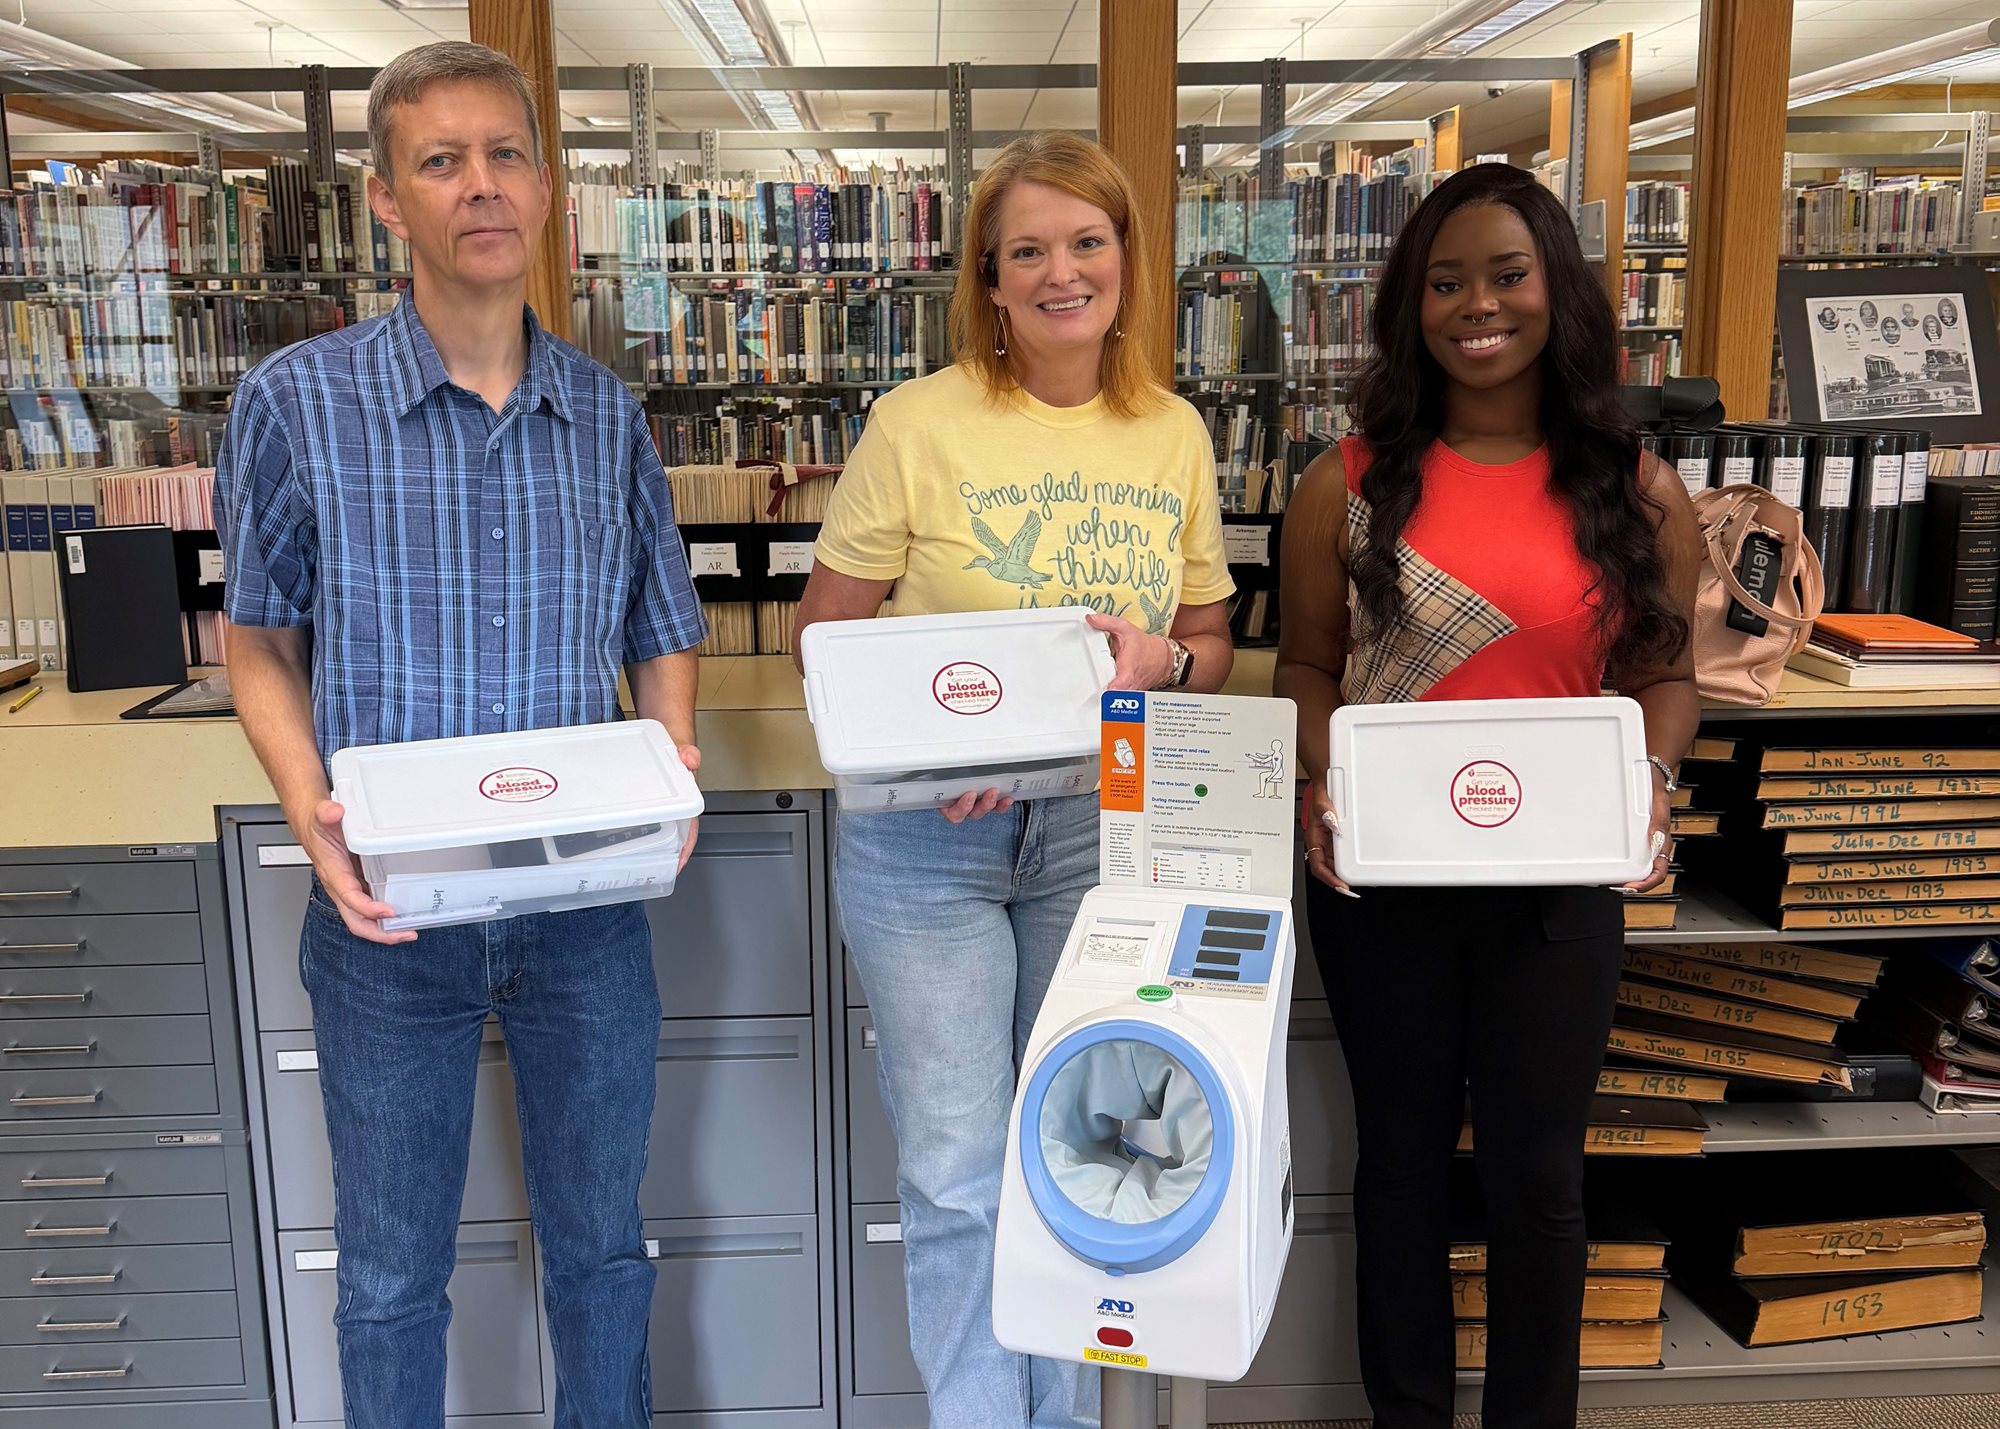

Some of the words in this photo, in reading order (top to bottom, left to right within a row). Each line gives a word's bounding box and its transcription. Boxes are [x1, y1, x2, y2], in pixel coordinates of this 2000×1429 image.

[819, 211, 829, 240] JESUS
[959, 481, 1027, 515] Some
[1031, 471, 1088, 520] glad
[1094, 482, 1184, 551] morning
[1066, 506, 1151, 549] when
[707, 562, 722, 571] AR
[785, 562, 800, 571] AR
[1048, 546, 1122, 587] this
[1122, 549, 1171, 600] life
[947, 680, 987, 691] blood
[942, 689, 998, 702] pressure
[1110, 699, 1140, 710] AND
[1922, 753, 1951, 768] 92
[489, 784, 552, 796] pressure
[496, 779, 541, 789] blood
[1466, 785, 1506, 795] blood
[1459, 797, 1516, 807] pressure
[1934, 831, 1976, 846] 1994
[1945, 858, 1987, 873] 1993
[1906, 883, 1945, 898] 1993
[1959, 905, 1994, 919] 92
[1760, 949, 1801, 971] 1987
[1731, 977, 1767, 994] 1986
[1714, 1004, 1758, 1023] 1985
[1704, 1048, 1750, 1066] 1985
[1641, 1077, 1688, 1095] 1986
[1096, 1298, 1135, 1314] AND
[1822, 1292, 1883, 1326] 1983
[1111, 1312, 1135, 1320] Medical
[1101, 1352, 1119, 1361] FAST
[1121, 1355, 1141, 1364] STOP
